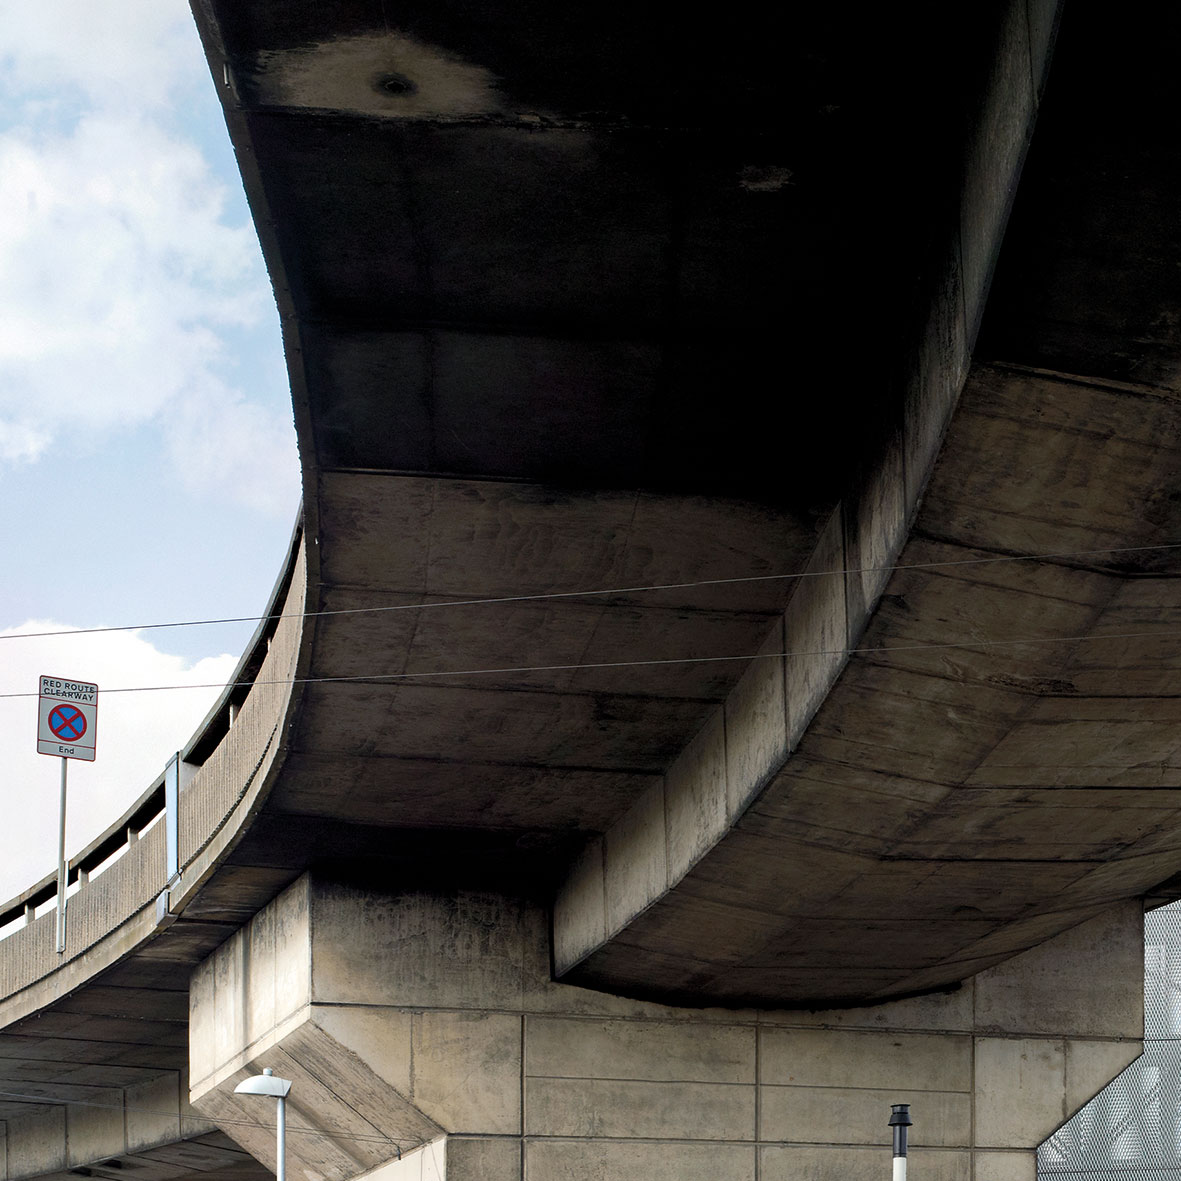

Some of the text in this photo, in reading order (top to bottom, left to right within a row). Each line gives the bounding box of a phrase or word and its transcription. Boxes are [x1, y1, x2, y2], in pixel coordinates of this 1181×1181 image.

[43, 679, 95, 693] RED ROUTE
[43, 688, 94, 701] CLEARWAY
[58, 745, 75, 755] End
